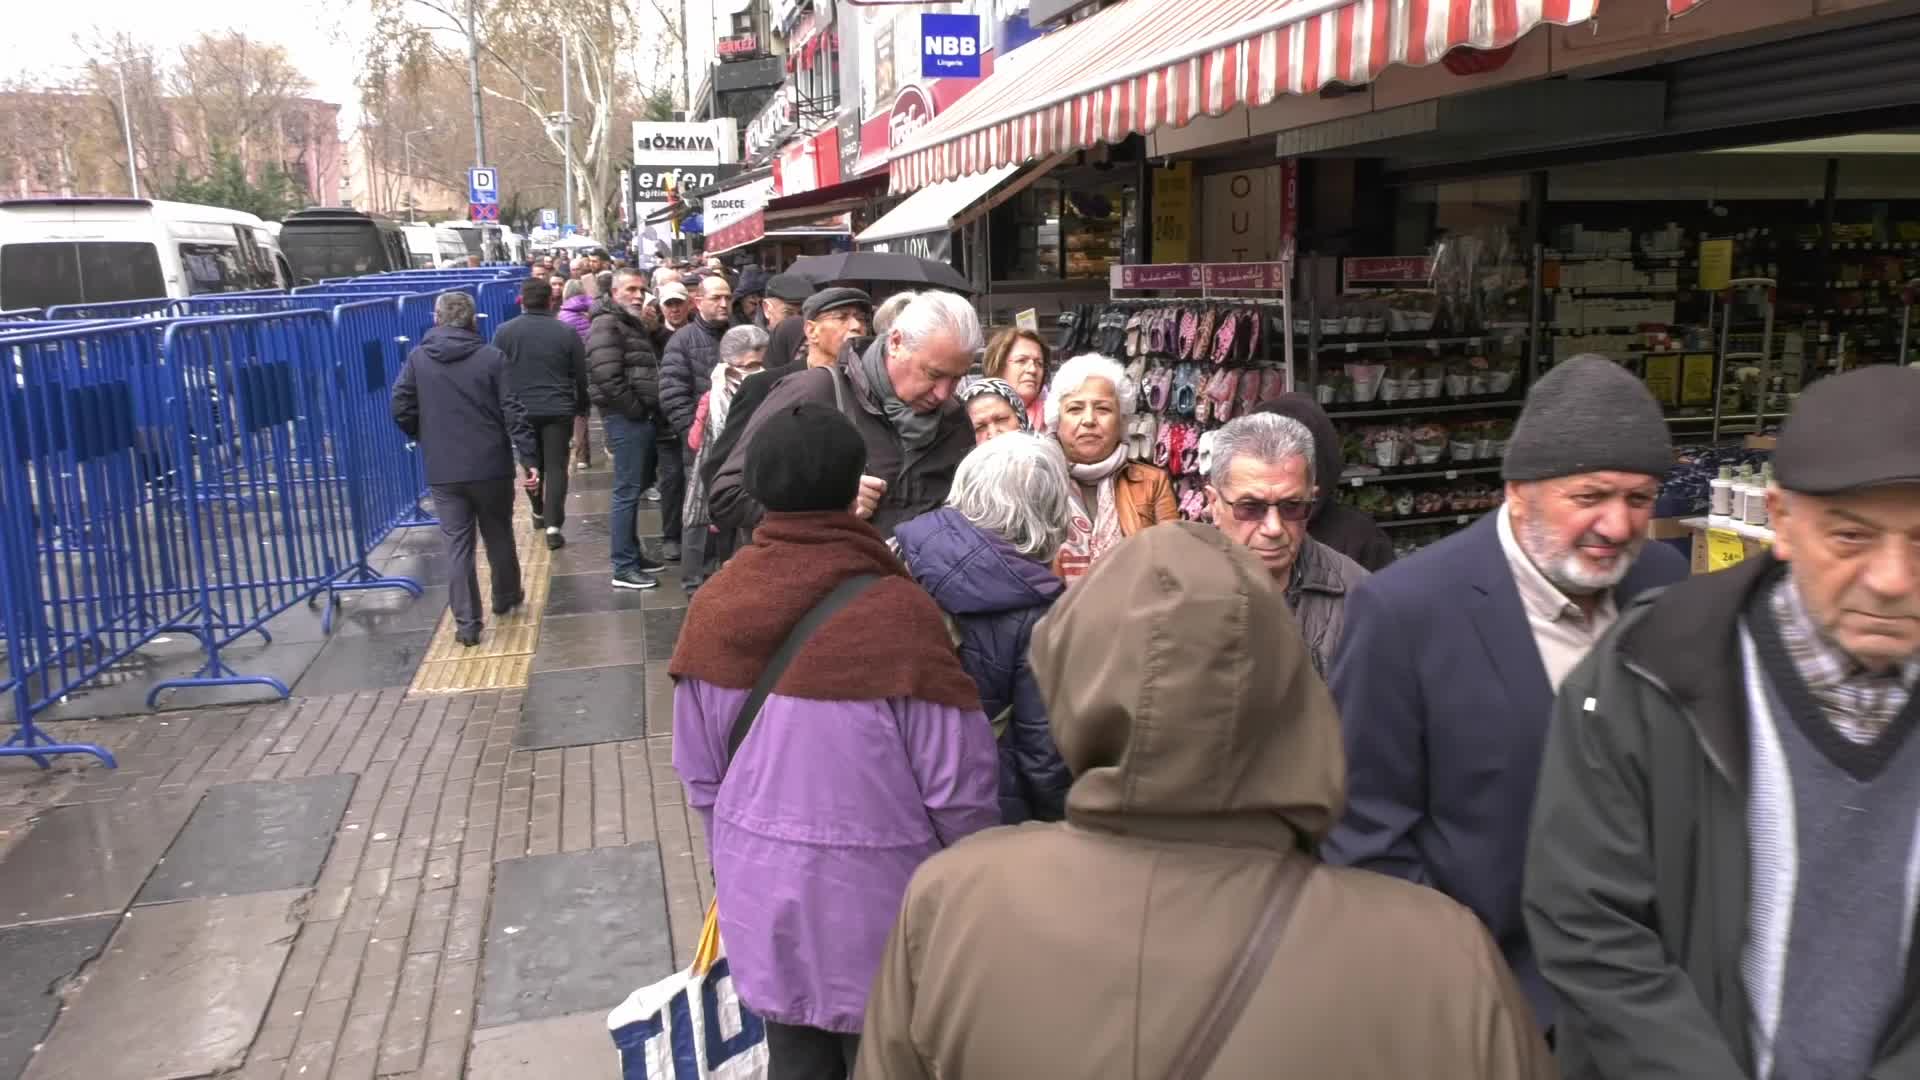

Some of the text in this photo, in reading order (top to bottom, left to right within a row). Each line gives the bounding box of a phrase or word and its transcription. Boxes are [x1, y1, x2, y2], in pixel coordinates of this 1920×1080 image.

[925, 36, 976, 55] NBB
[652, 133, 714, 151] ÖZKAYA
[477, 172, 490, 187] D
[638, 168, 715, 188] erfen
[711, 199, 745, 209] SADECE
